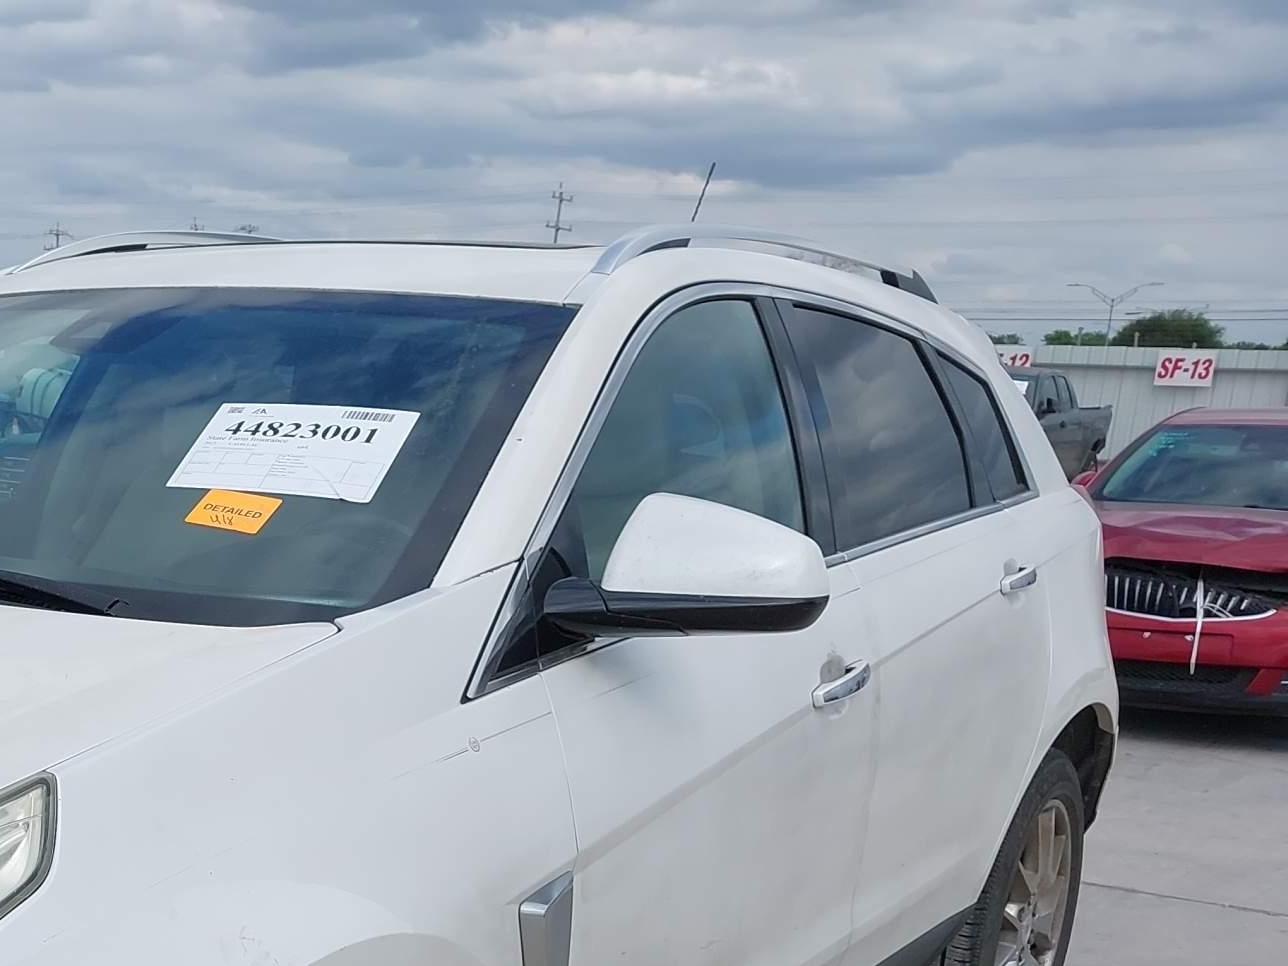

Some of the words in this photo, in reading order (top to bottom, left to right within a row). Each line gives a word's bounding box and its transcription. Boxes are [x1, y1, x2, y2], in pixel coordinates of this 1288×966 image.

[1156, 357, 1214, 380] SF-13
[224, 420, 380, 445] 44823001
[203, 503, 263, 519] DETAILED
